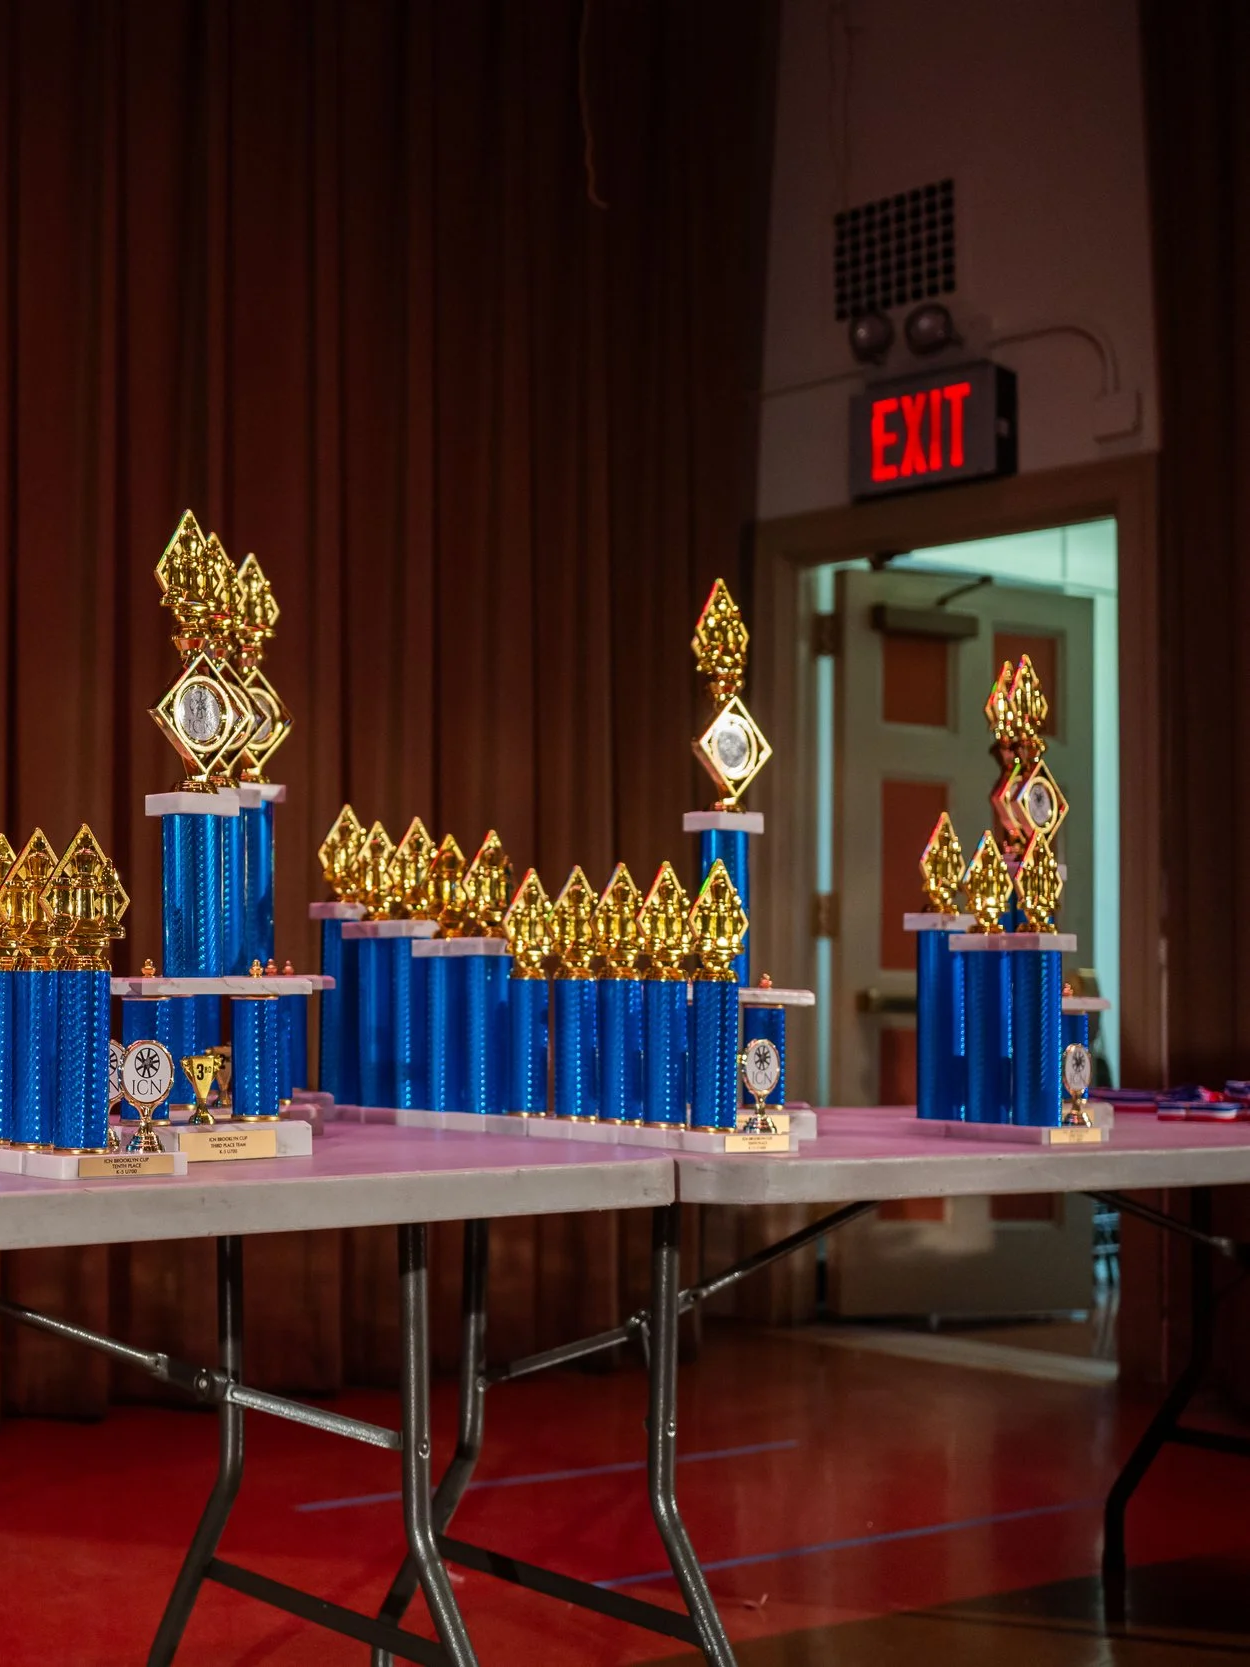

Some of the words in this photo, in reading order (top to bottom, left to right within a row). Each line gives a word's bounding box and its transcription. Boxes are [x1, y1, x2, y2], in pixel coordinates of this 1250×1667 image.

[871, 381, 971, 483] EXIT
[196, 1063, 212, 1081] 3RD
[752, 1071, 773, 1085] ICN
[132, 1079, 163, 1096] ICN
